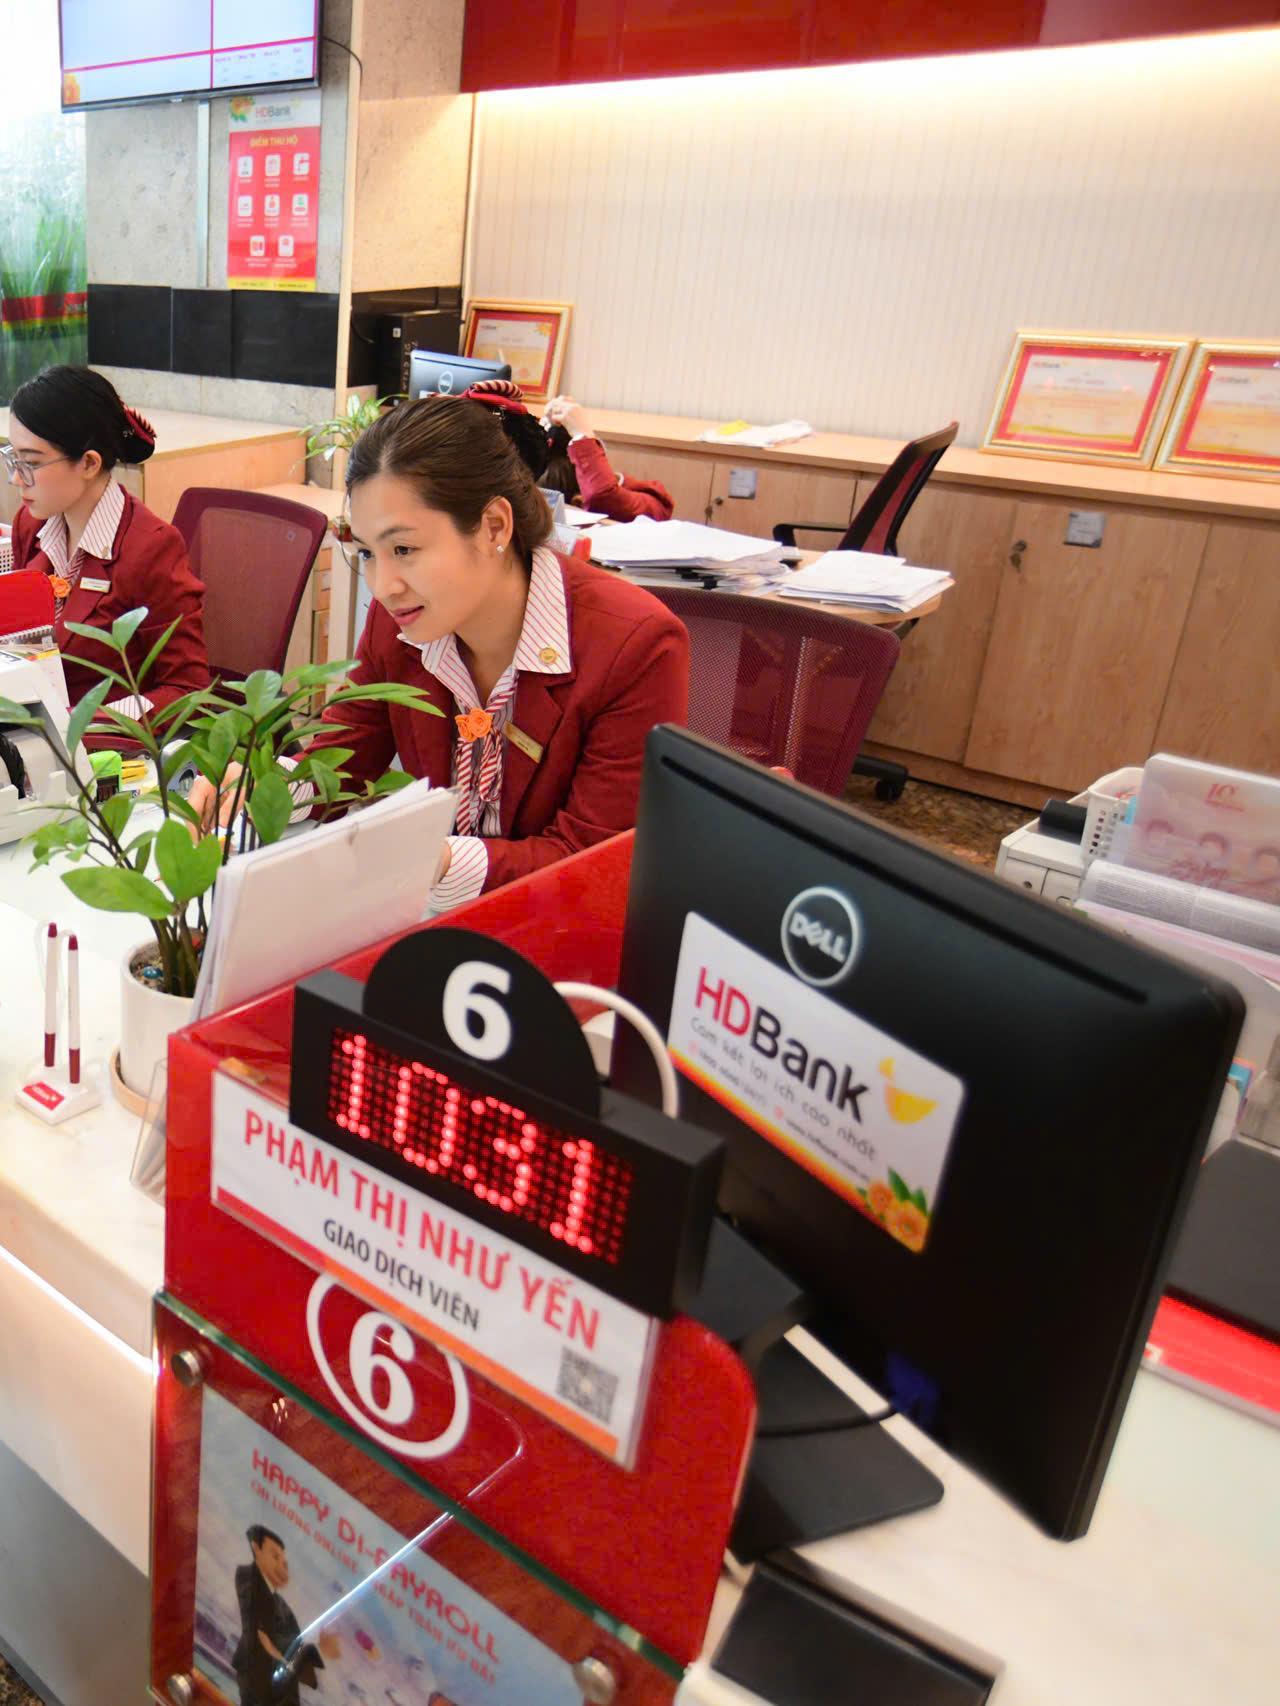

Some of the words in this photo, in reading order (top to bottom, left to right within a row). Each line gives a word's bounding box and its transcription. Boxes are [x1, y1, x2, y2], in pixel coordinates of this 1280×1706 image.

[789, 911, 848, 963] DELL
[442, 960, 512, 1061] 6
[694, 966, 873, 1124] HDBank
[337, 1034, 593, 1254] 1031
[243, 1109, 340, 1196] PHẠM
[351, 1168, 408, 1249] THỊ
[419, 1217, 511, 1292] NHƯ
[518, 1266, 600, 1351] YẾN
[323, 1219, 370, 1263] GIAO
[375, 1247, 423, 1293] DỊCH
[429, 1277, 480, 1332] VIÊN
[349, 1311, 415, 1426] 6
[251, 1448, 332, 1522] HAPPY
